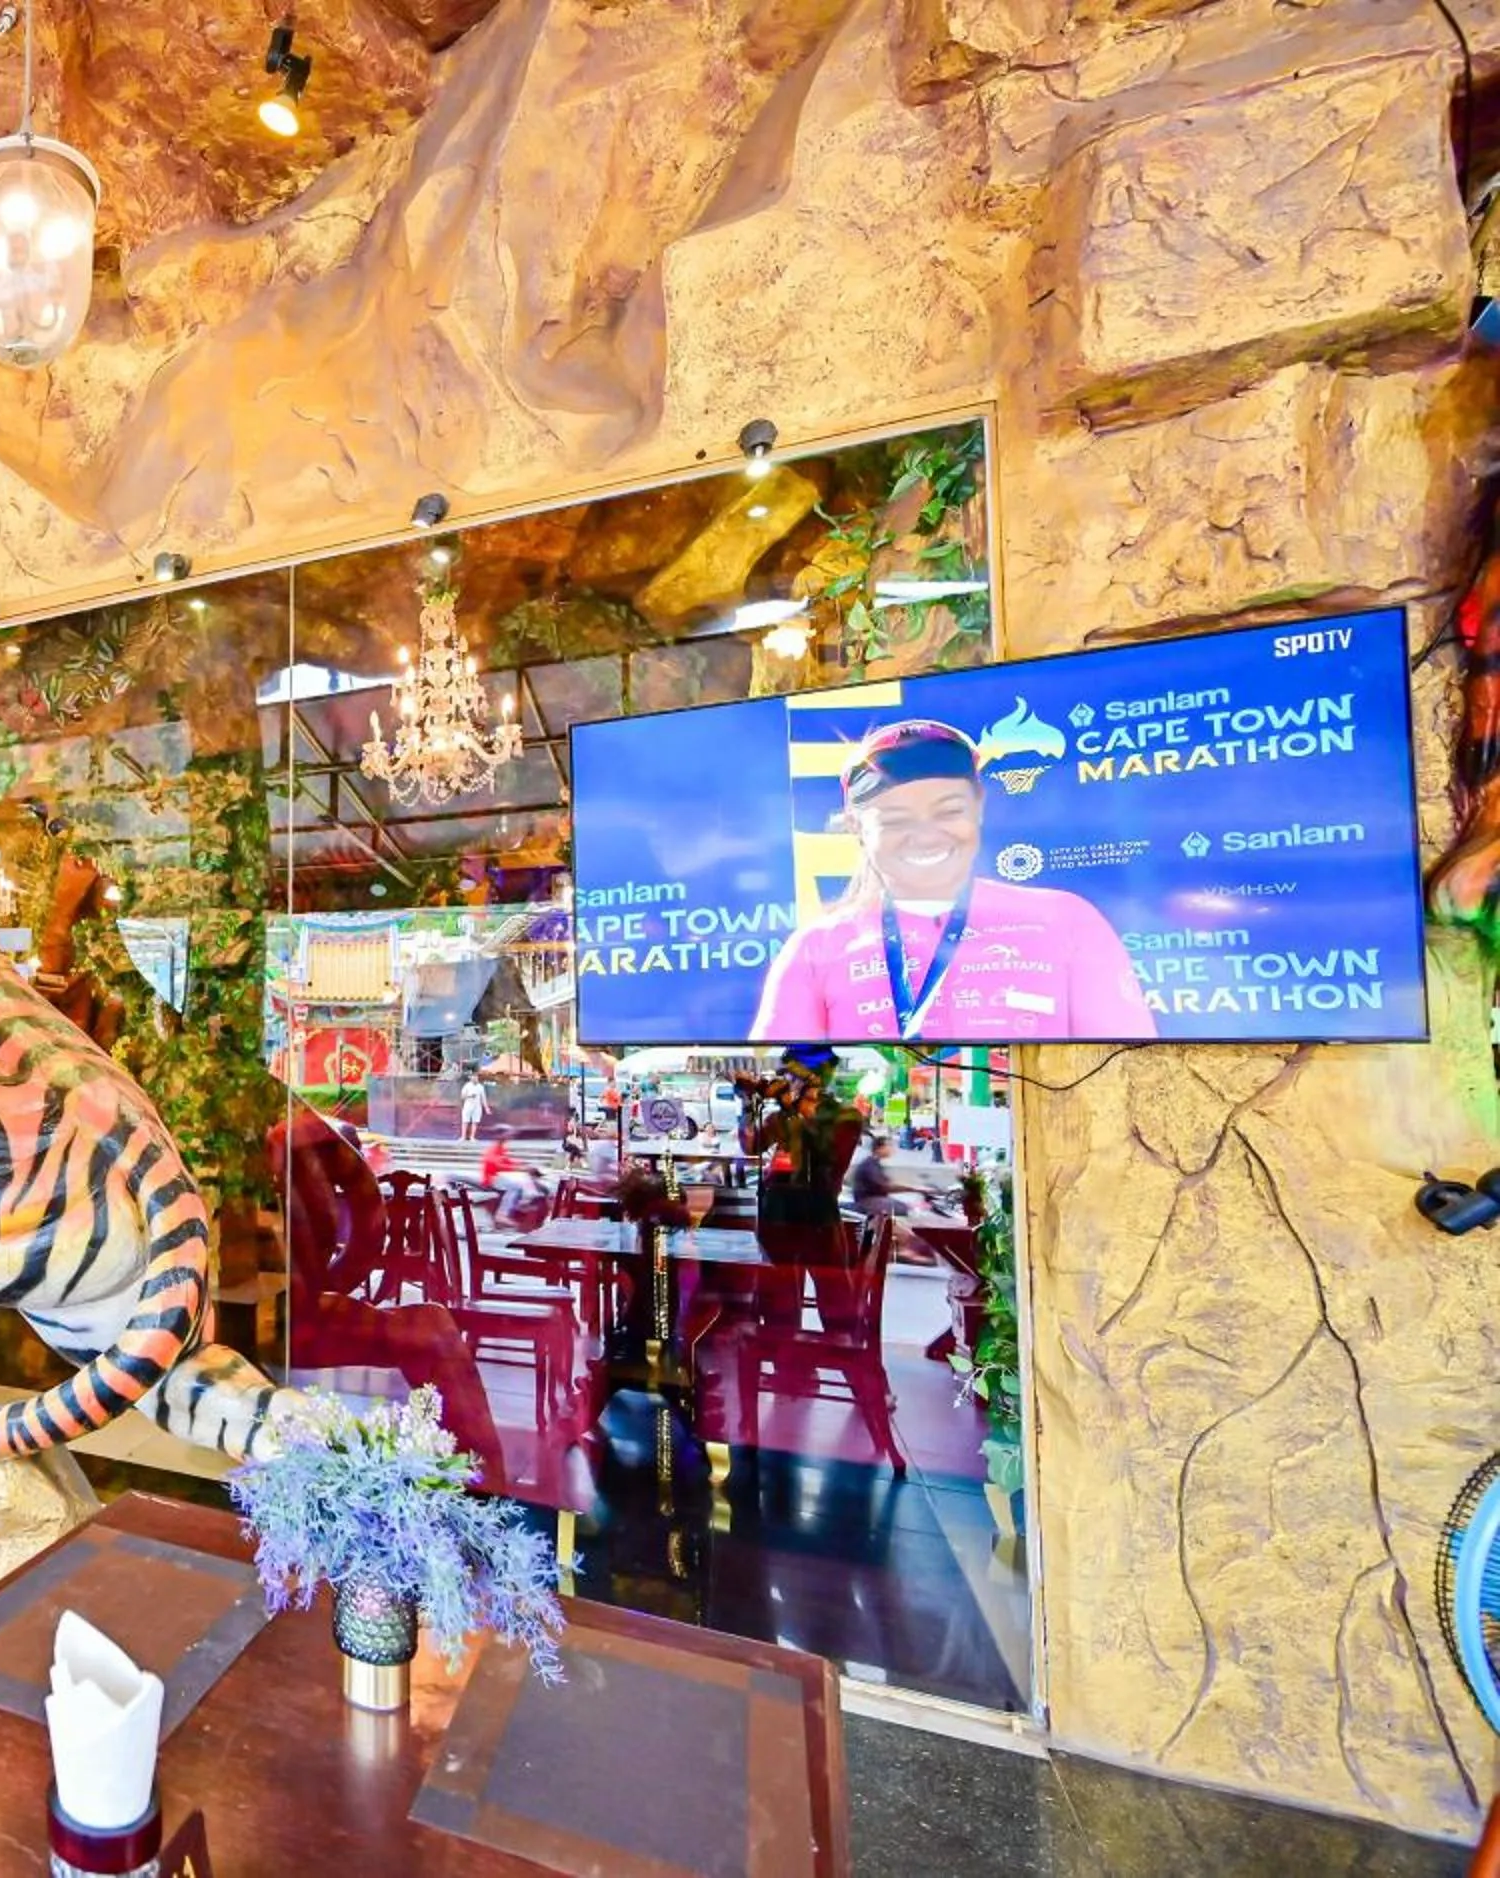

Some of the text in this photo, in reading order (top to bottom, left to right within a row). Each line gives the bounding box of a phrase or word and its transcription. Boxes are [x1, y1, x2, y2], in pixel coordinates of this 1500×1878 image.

[1274, 628, 1353, 658] SPOTV
[1105, 687, 1230, 721] Sanlam
[1076, 694, 1356, 755] CAPE TOWN
[1077, 725, 1356, 784] MARATHON
[1222, 821, 1365, 851] Sanlam
[577, 902, 797, 943] APE TOWN
[1121, 927, 1249, 951] Sanlam
[579, 938, 784, 977] ARATHO
[1130, 948, 1380, 984] APE TOWN
[1143, 980, 1384, 1015] ARATHON
